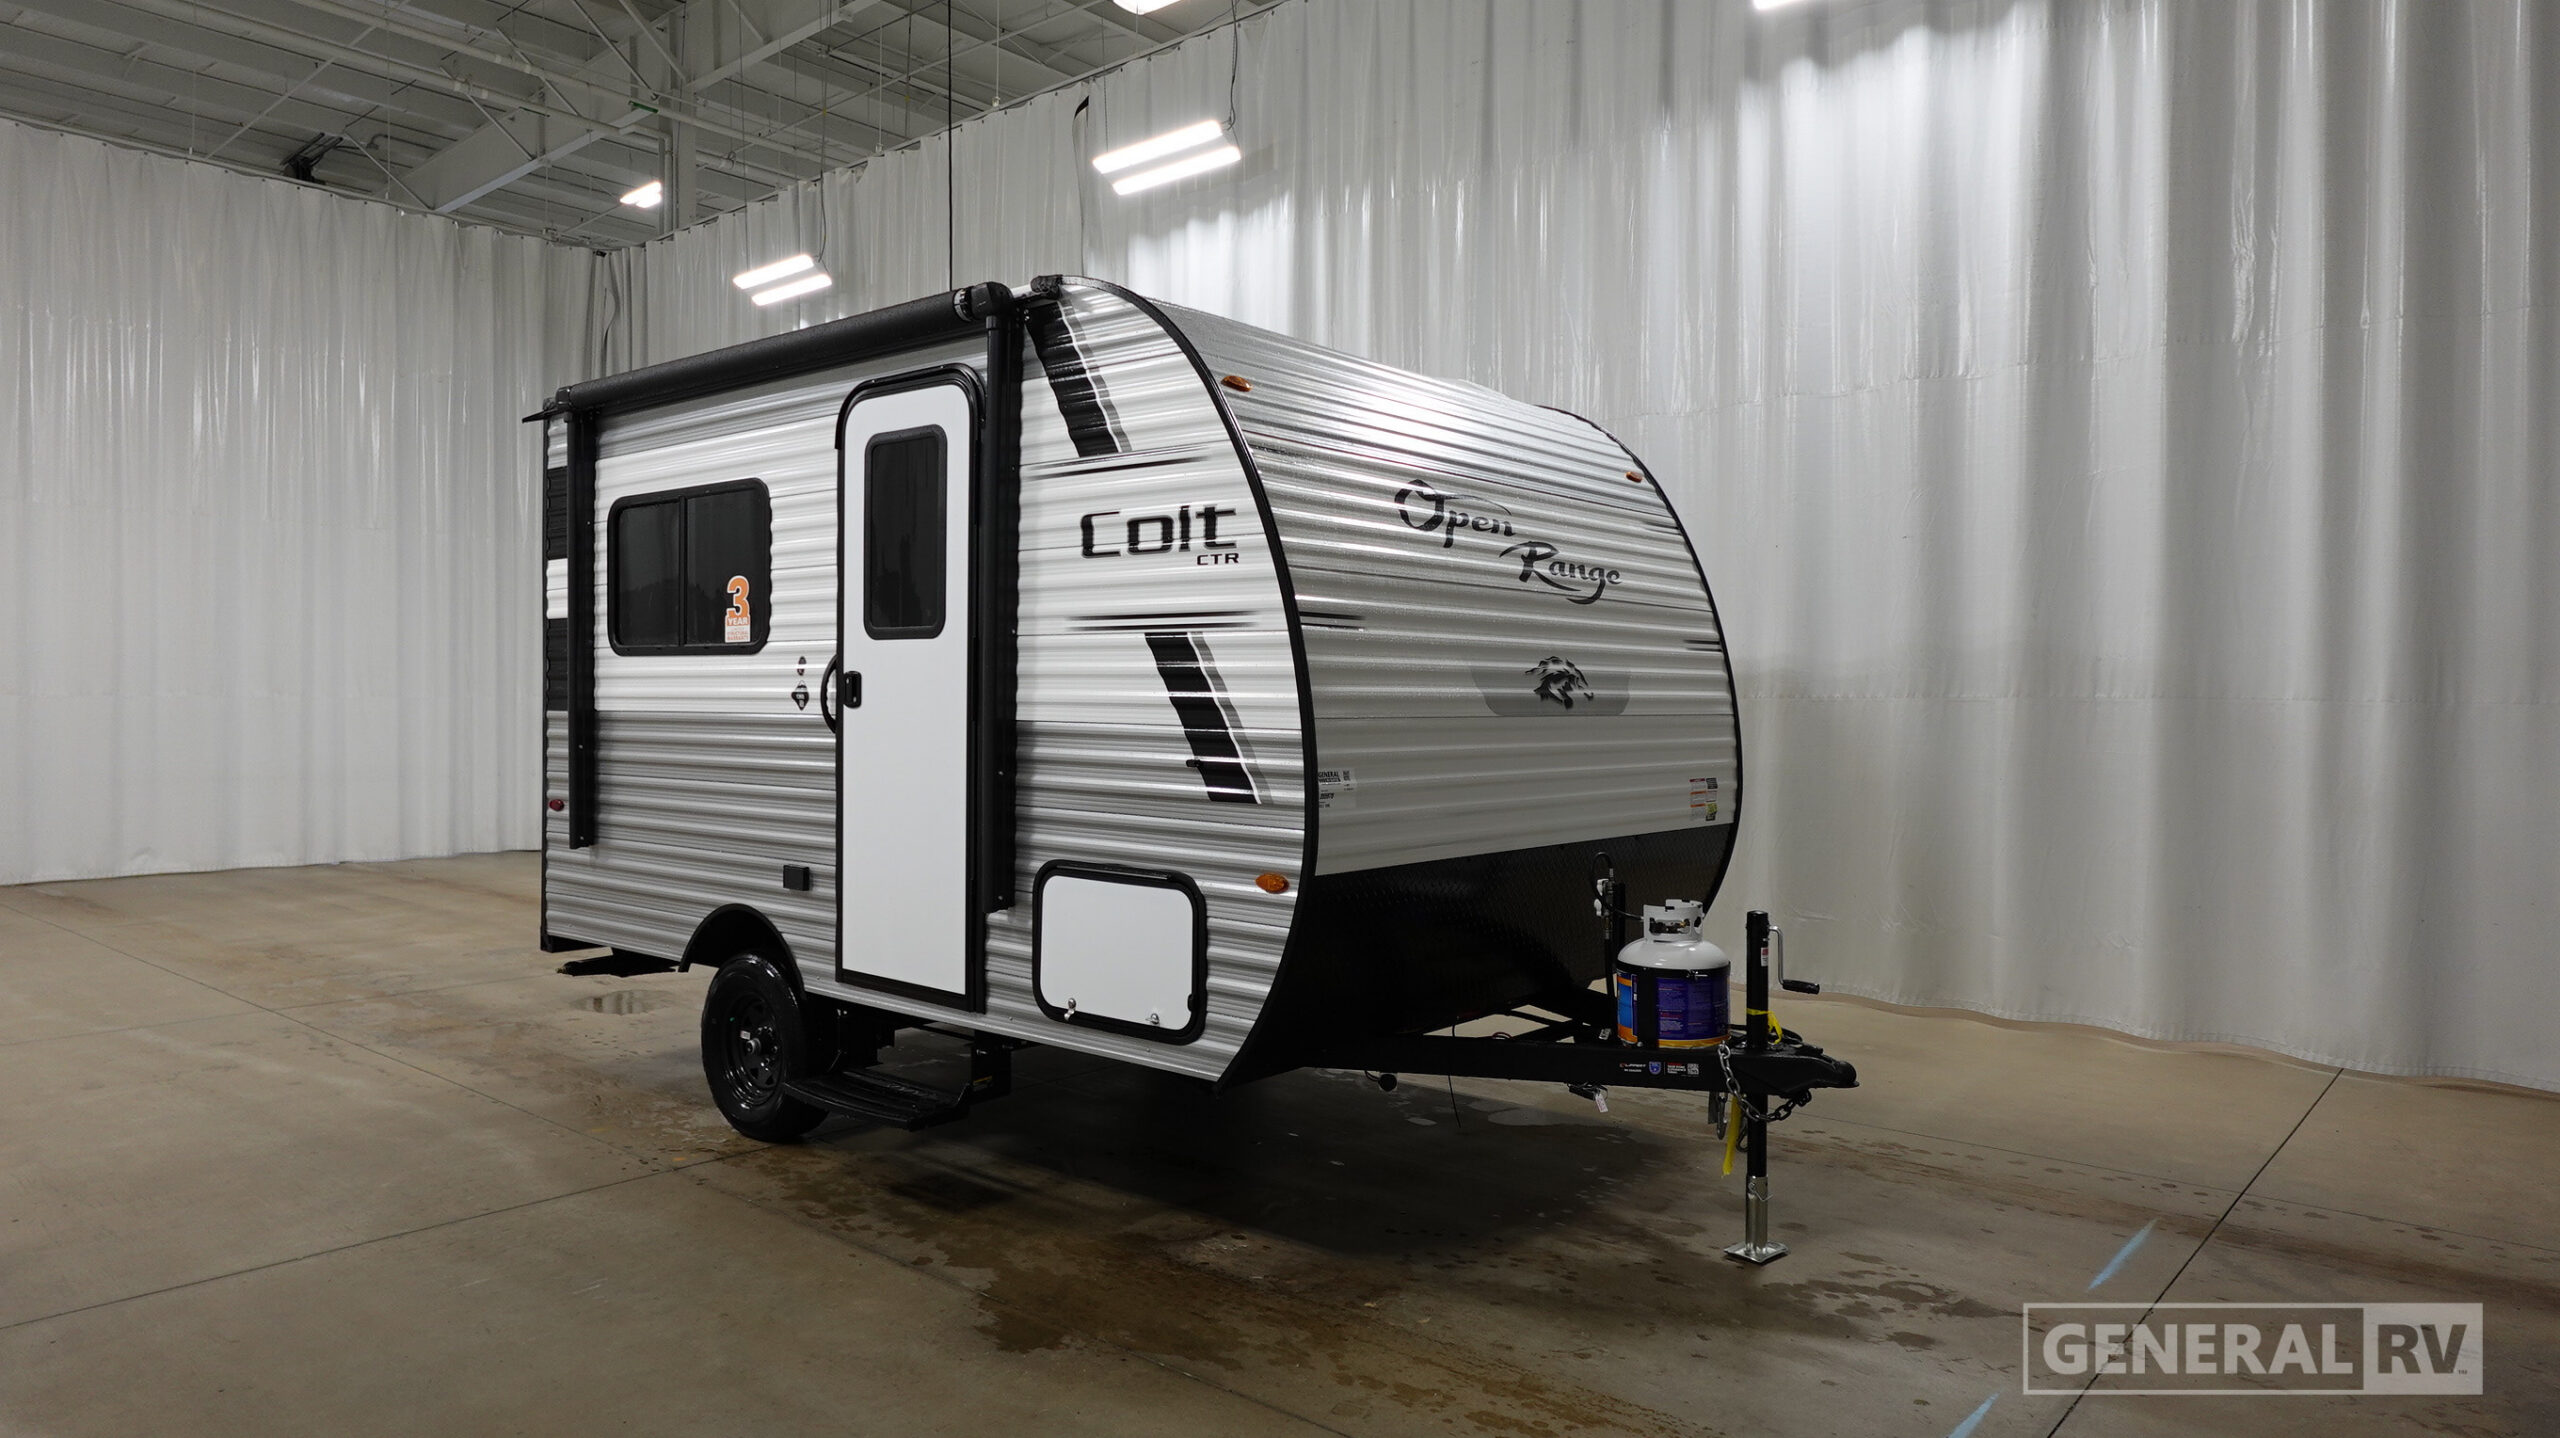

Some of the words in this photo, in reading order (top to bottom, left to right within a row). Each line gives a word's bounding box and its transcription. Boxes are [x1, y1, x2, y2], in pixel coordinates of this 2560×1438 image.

[1080, 503, 1236, 558] Colt
[1394, 478, 1517, 548] Open
[1196, 552, 1239, 566] CTR
[1499, 541, 1623, 605] Range
[727, 575, 750, 617] 3
[728, 616, 749, 626] YEAR
